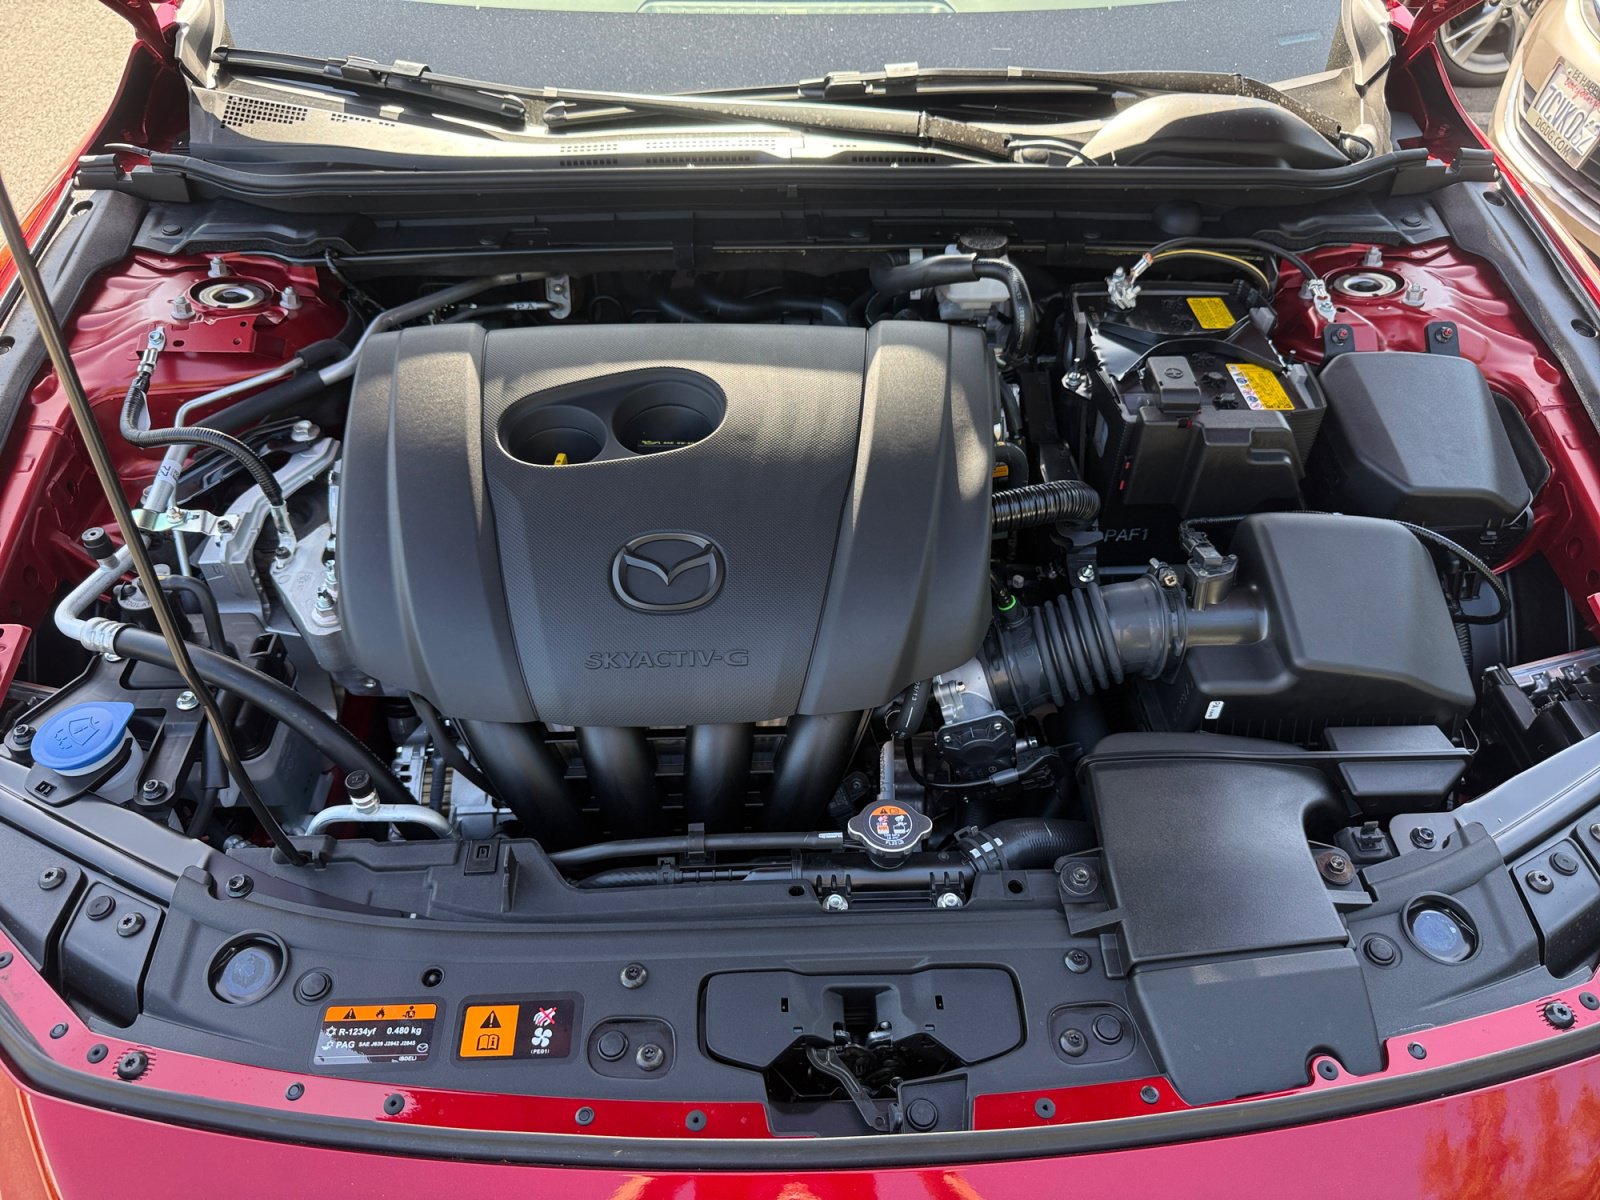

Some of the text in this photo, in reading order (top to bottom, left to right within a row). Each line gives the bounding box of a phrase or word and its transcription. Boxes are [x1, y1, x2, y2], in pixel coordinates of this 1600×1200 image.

[1535, 117, 1572, 158] DGDG.COM
[1103, 528, 1149, 542] PAF1
[584, 649, 749, 670] SKYACTIV-G
[338, 1027, 377, 1037] R-1234yf
[411, 1026, 422, 1036] kg
[335, 1040, 356, 1049] PAG
